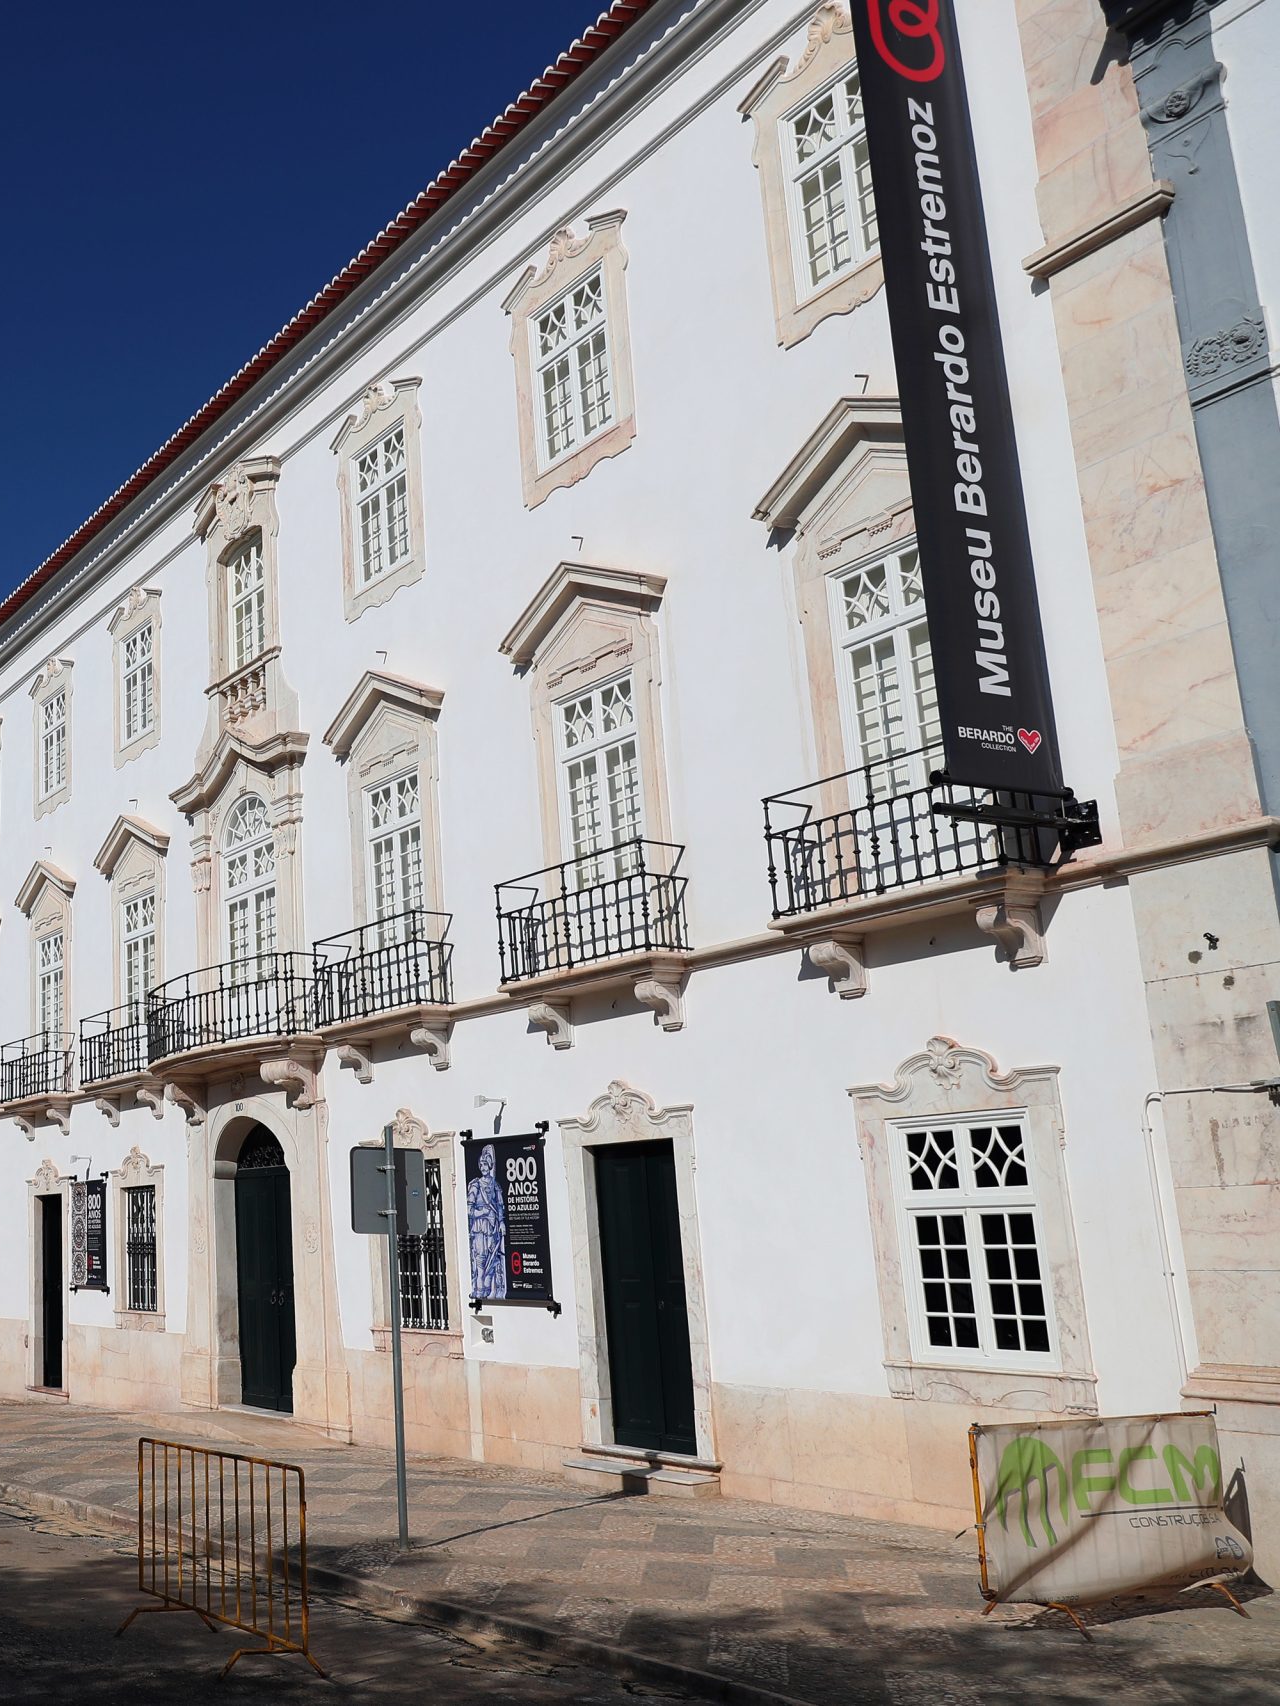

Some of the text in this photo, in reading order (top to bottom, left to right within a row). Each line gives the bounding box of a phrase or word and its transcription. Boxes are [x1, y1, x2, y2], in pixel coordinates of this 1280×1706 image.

[907, 97, 1012, 697] Museu Berardo Estremoz
[958, 726, 1015, 744] BERARDO
[981, 742, 1017, 752] COLLECTION
[506, 1156, 537, 1182] 800
[507, 1181, 538, 1196] ANOS
[87, 1194, 101, 1210] 800
[507, 1194, 539, 1204] DE HISTÓRIA
[508, 1203, 540, 1212] DO AZULEJO
